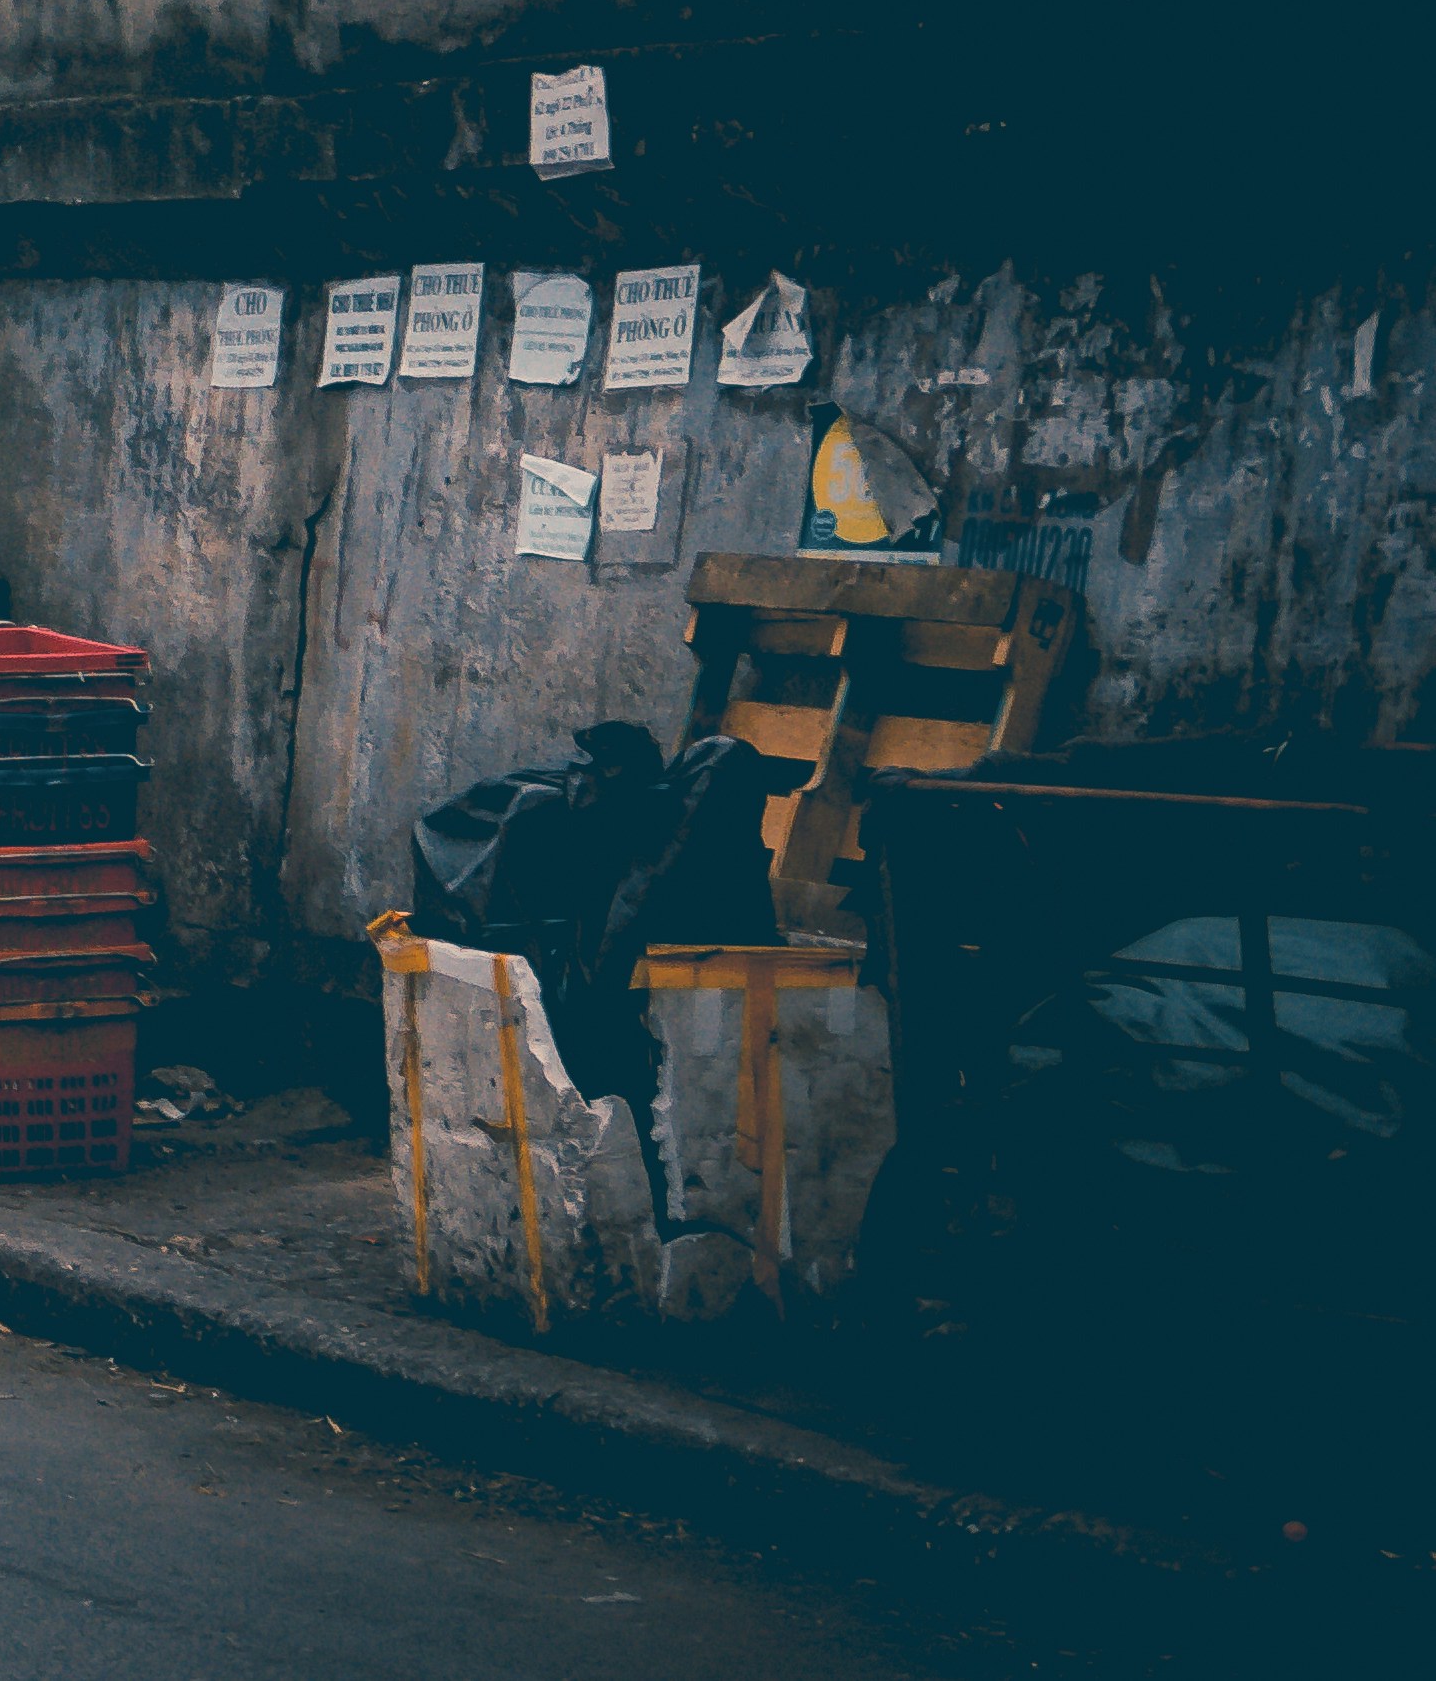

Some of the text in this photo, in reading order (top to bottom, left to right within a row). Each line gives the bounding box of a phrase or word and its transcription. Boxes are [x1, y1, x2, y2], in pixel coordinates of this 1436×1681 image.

[235, 291, 267, 316] CHO
[617, 281, 650, 305] CHO
[616, 313, 671, 343] PHÒNG
